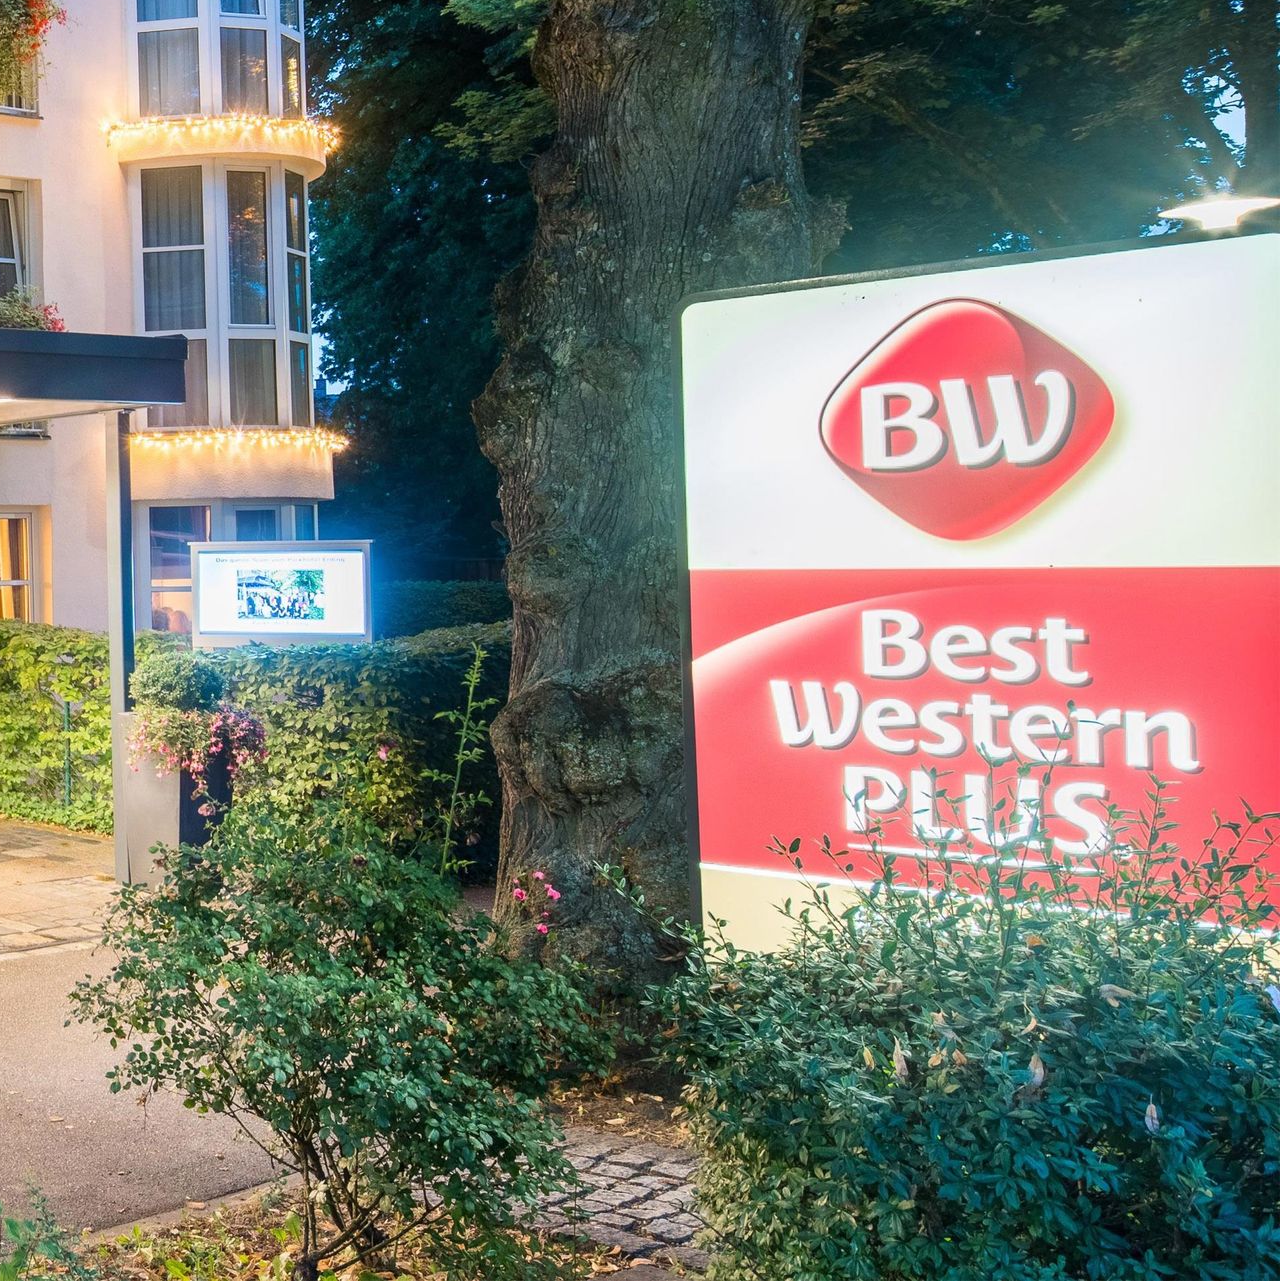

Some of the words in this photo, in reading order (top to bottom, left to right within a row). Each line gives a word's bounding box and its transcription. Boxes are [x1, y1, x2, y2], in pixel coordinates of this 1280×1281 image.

[861, 370, 1077, 473] BW
[862, 609, 1092, 688] Best
[770, 680, 1204, 773] Western
[844, 766, 1115, 858] PLUS
